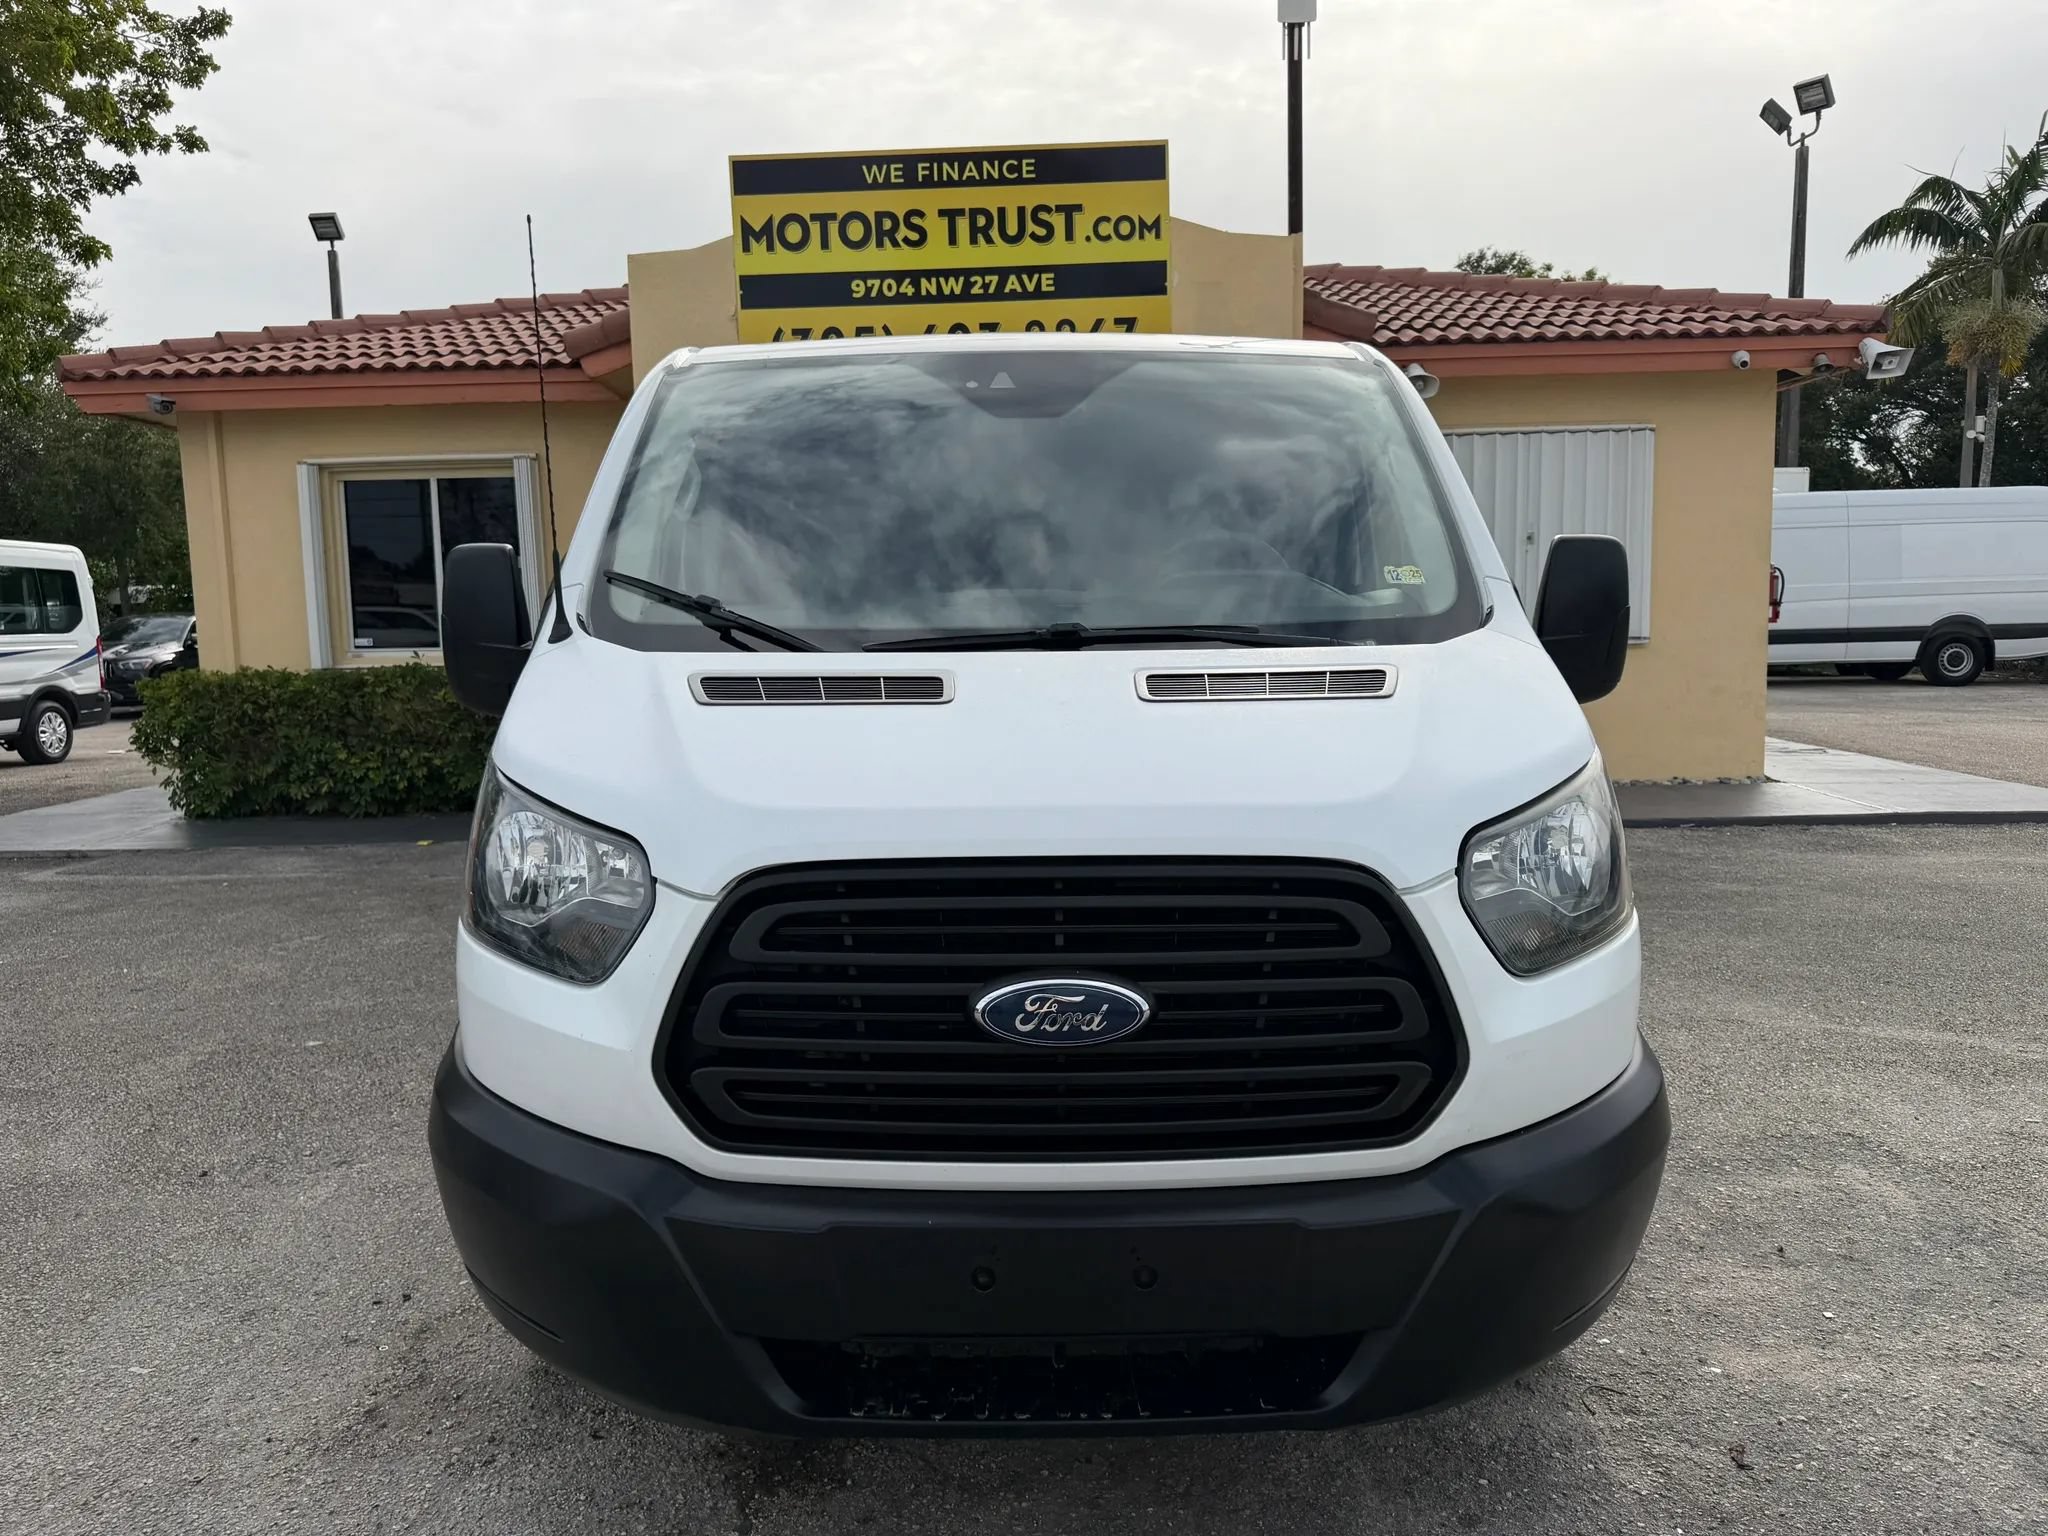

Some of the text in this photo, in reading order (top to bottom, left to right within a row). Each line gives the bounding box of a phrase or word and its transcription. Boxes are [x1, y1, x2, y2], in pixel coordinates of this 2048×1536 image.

[862, 158, 1036, 184] WE FINANCE
[740, 208, 928, 255] MOTORS
[850, 273, 1056, 298] 9704 NW 27 AVE
[1015, 993, 1109, 1032] Ford
